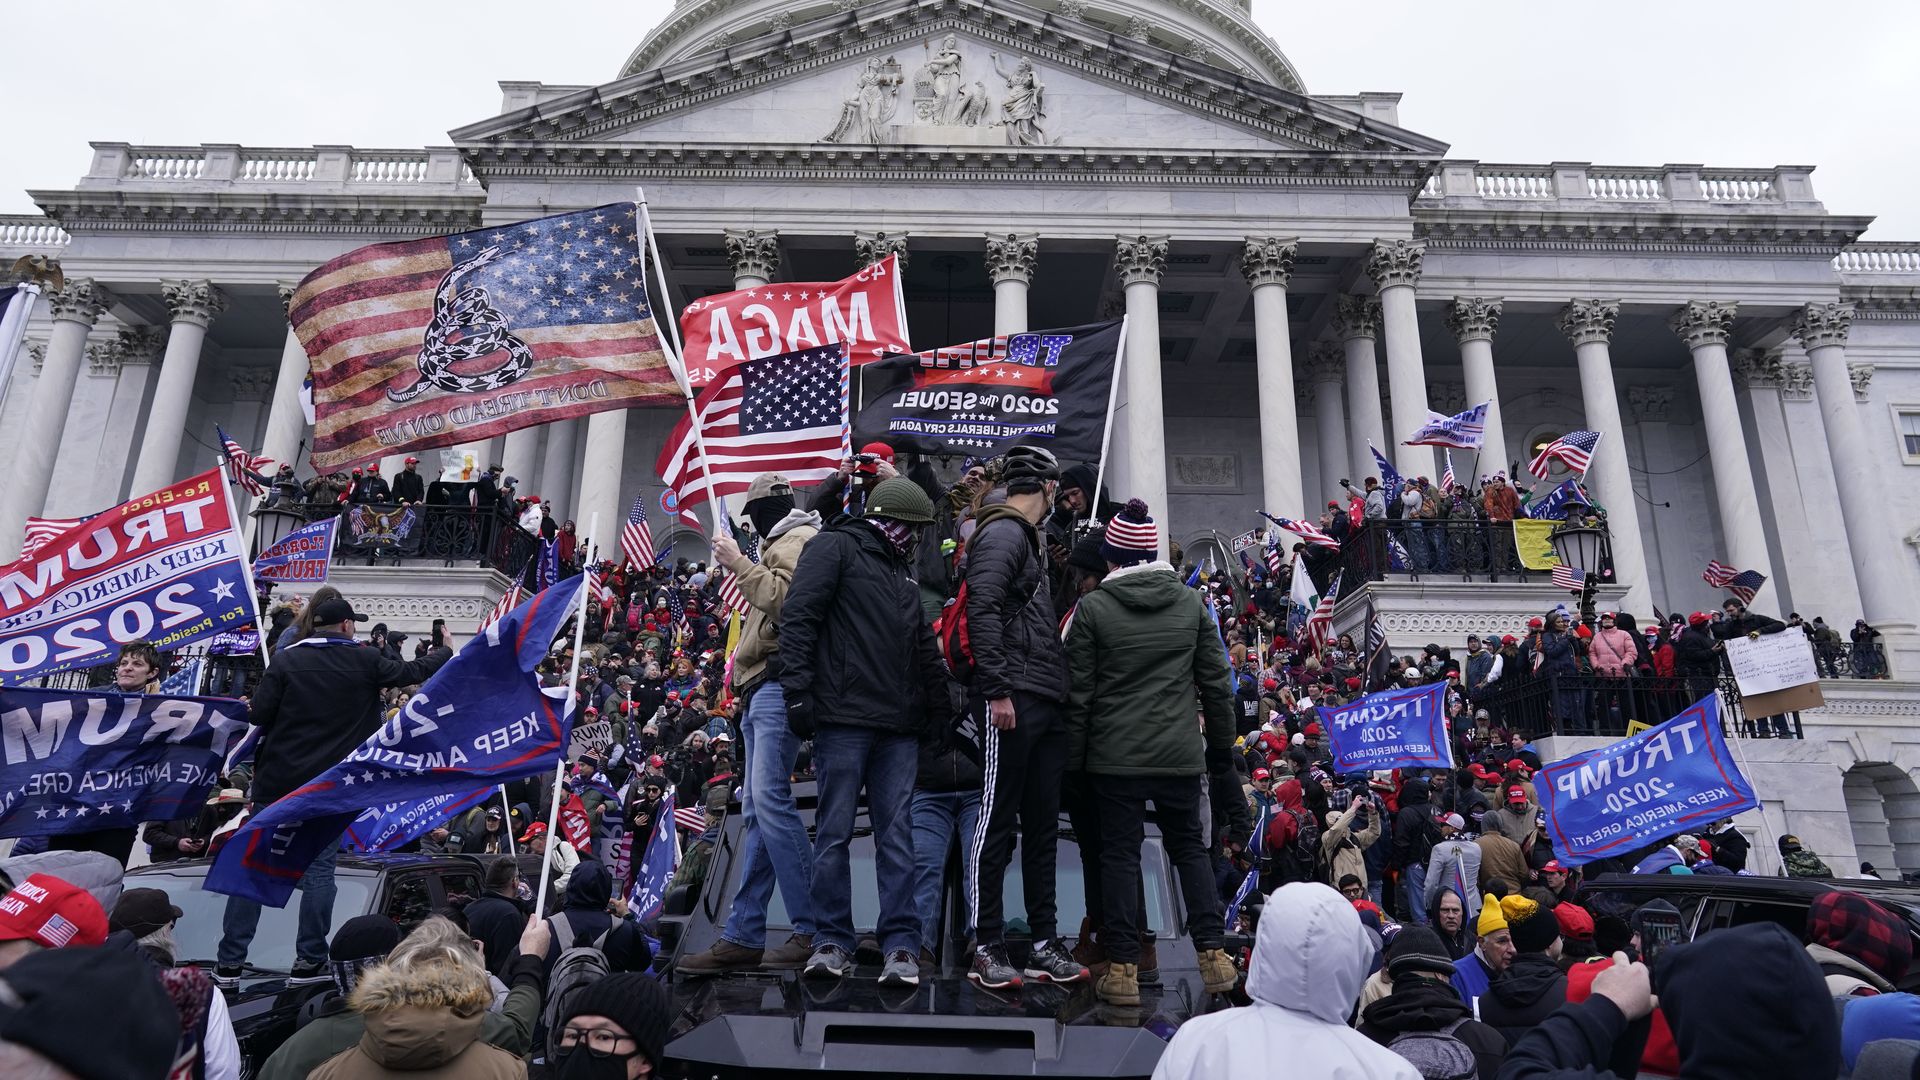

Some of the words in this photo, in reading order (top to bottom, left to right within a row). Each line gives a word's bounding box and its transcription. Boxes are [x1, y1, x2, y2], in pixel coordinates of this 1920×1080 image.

[213, 637, 256, 647] SWAMP
[570, 723, 611, 744] RUMP
[581, 739, 610, 755] WON
